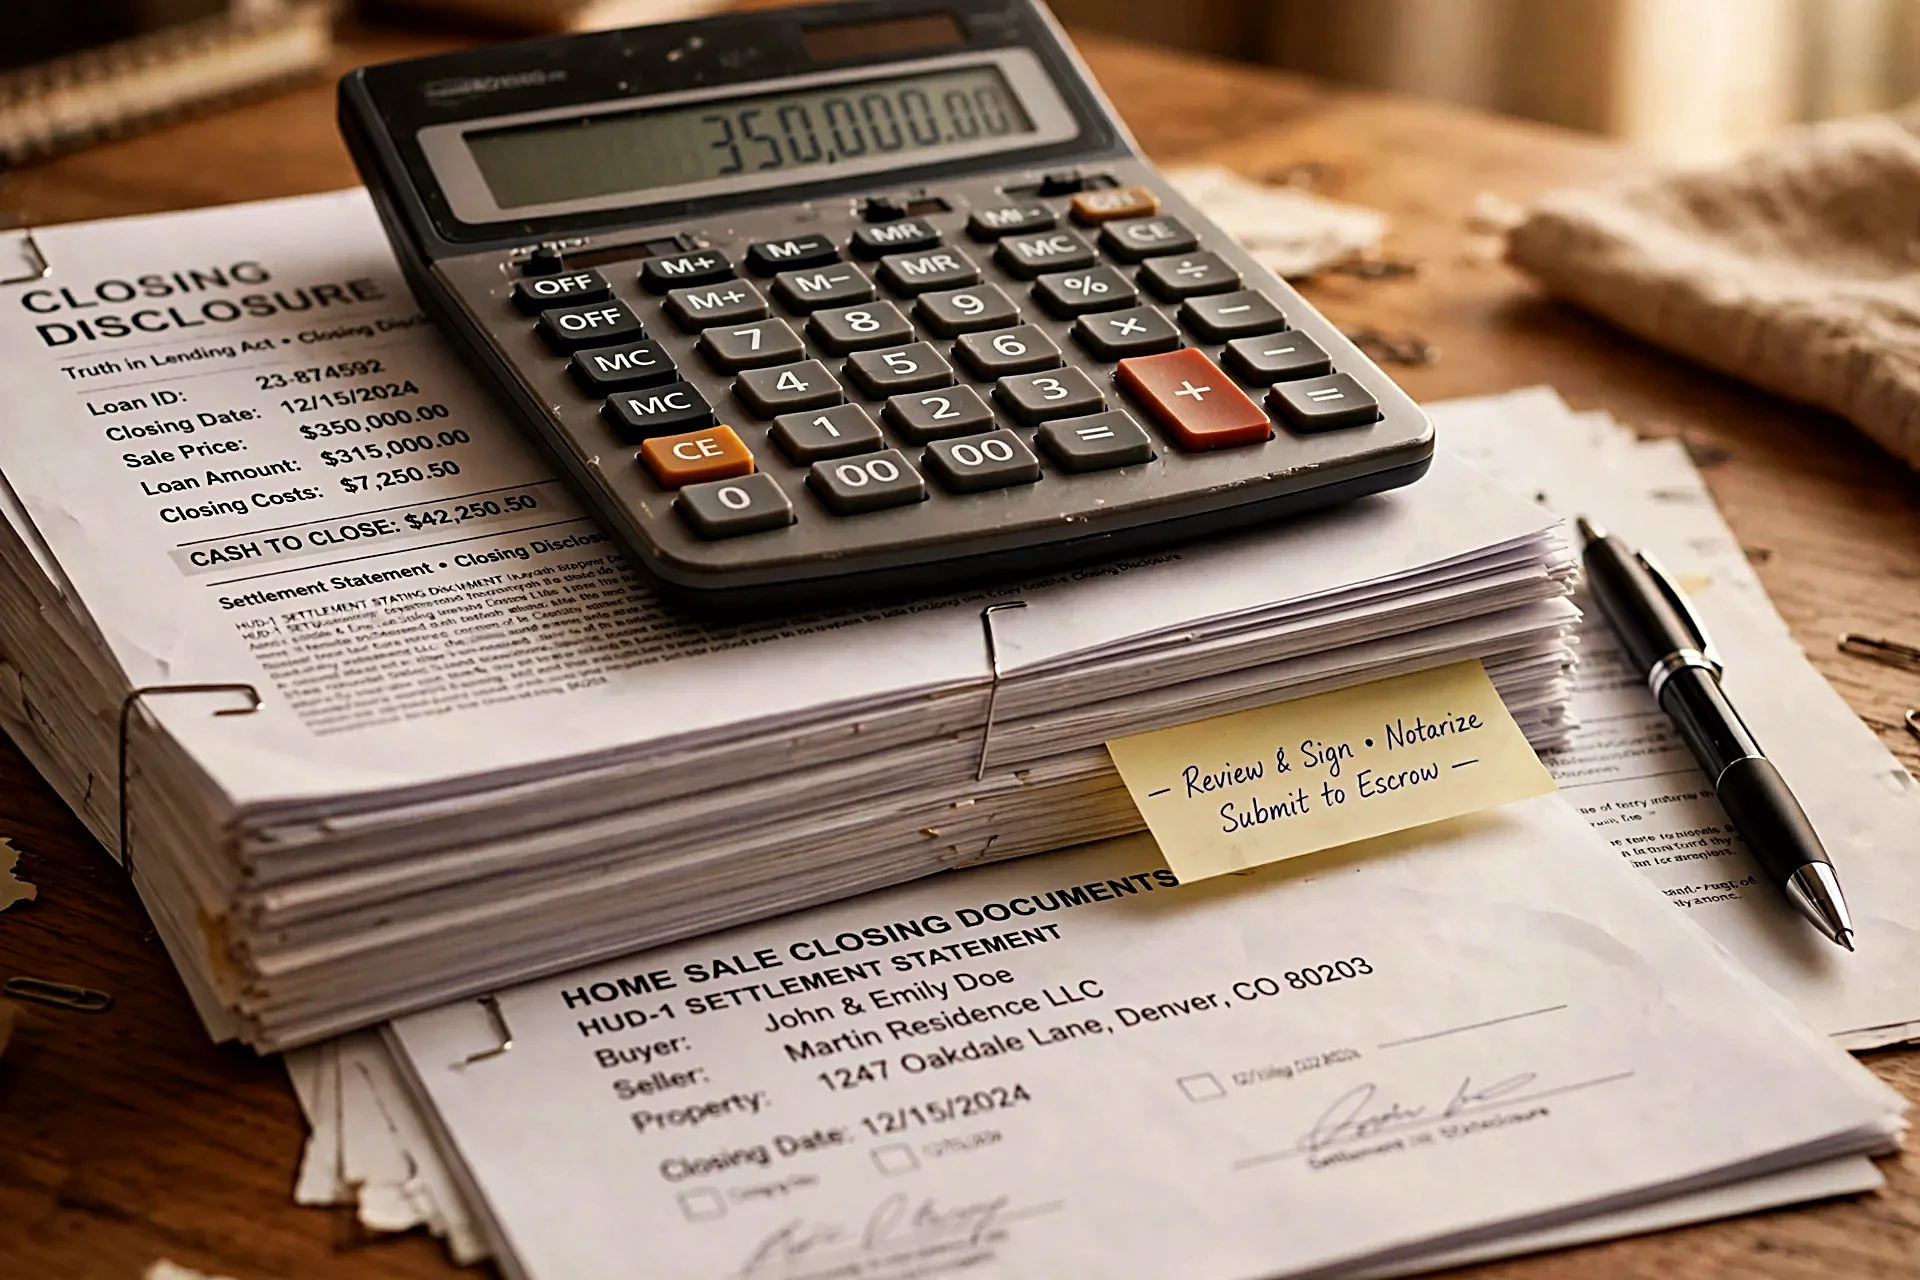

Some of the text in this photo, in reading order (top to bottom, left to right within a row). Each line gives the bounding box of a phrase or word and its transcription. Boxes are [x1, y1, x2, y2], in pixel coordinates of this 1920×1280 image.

[701, 84, 1010, 175] 350,000.00
[869, 221, 924, 243] MR
[1126, 221, 1175, 243] CE
[1017, 235, 1077, 258] MC
[661, 256, 716, 276] M+
[901, 254, 961, 276] MR
[22, 261, 271, 314] CLOSING
[533, 273, 593, 296] OFF
[1064, 275, 1109, 296] %
[36, 277, 386, 347] DISCLOSURE
[687, 289, 746, 311] M+
[951, 293, 985, 316] 9
[558, 308, 621, 332] OFF
[844, 311, 880, 332] 8
[62, 359, 122, 381] Truth
[125, 357, 146, 371] in
[151, 342, 236, 367] Lending
[241, 337, 275, 353] Act
[298, 323, 374, 344] Closing
[733, 328, 762, 350] 7
[992, 333, 1027, 356] 6
[595, 348, 656, 373] MC
[882, 351, 918, 375] 5
[87, 359, 386, 417] Loan ID: 23-874592
[776, 371, 809, 393] 4
[1031, 377, 1069, 401] 3
[106, 380, 419, 443] Closing Date: 12/15/2024
[628, 391, 691, 417] MC
[921, 397, 961, 420] 2
[122, 403, 450, 469] Sale Price: $350,000.00
[812, 415, 841, 438] 1
[141, 428, 470, 496] Loan Amount: $315,000.00
[671, 438, 724, 461] CE
[950, 438, 1015, 467] 00
[835, 458, 900, 488] 00
[159, 460, 461, 524] Closing Costs: $7,250.50
[717, 486, 751, 512] 0
[189, 494, 538, 568] CASH TO CLOSE: $42,250.50
[218, 581, 328, 612] Settlement
[330, 562, 435, 590] Statement
[454, 544, 530, 567] Closing
[235, 616, 277, 630] HUD-1
[281, 600, 367, 624] SETTLEMENT
[1182, 758, 1264, 798] Review
[1300, 738, 1354, 777] Sign
[1385, 711, 1484, 751] Notarize
[1219, 788, 1310, 833] Submit
[1321, 781, 1346, 806] to
[1357, 763, 1439, 799] Escrow
[560, 868, 1180, 1009] HOME SALE CLOSING DOCUMENTS
[577, 923, 1062, 1037] HUD-1 SETTLEMENT STATEMENT
[594, 969, 1014, 1070] Buyer: John & Emily Doe
[612, 979, 1104, 1100] Seller: Martin Residence LLC
[631, 956, 1374, 1134] Property: 1247 Oakdale Lane, Denver, CO 80203
[658, 1083, 1032, 1183] Closing Date: 12/15/2024
